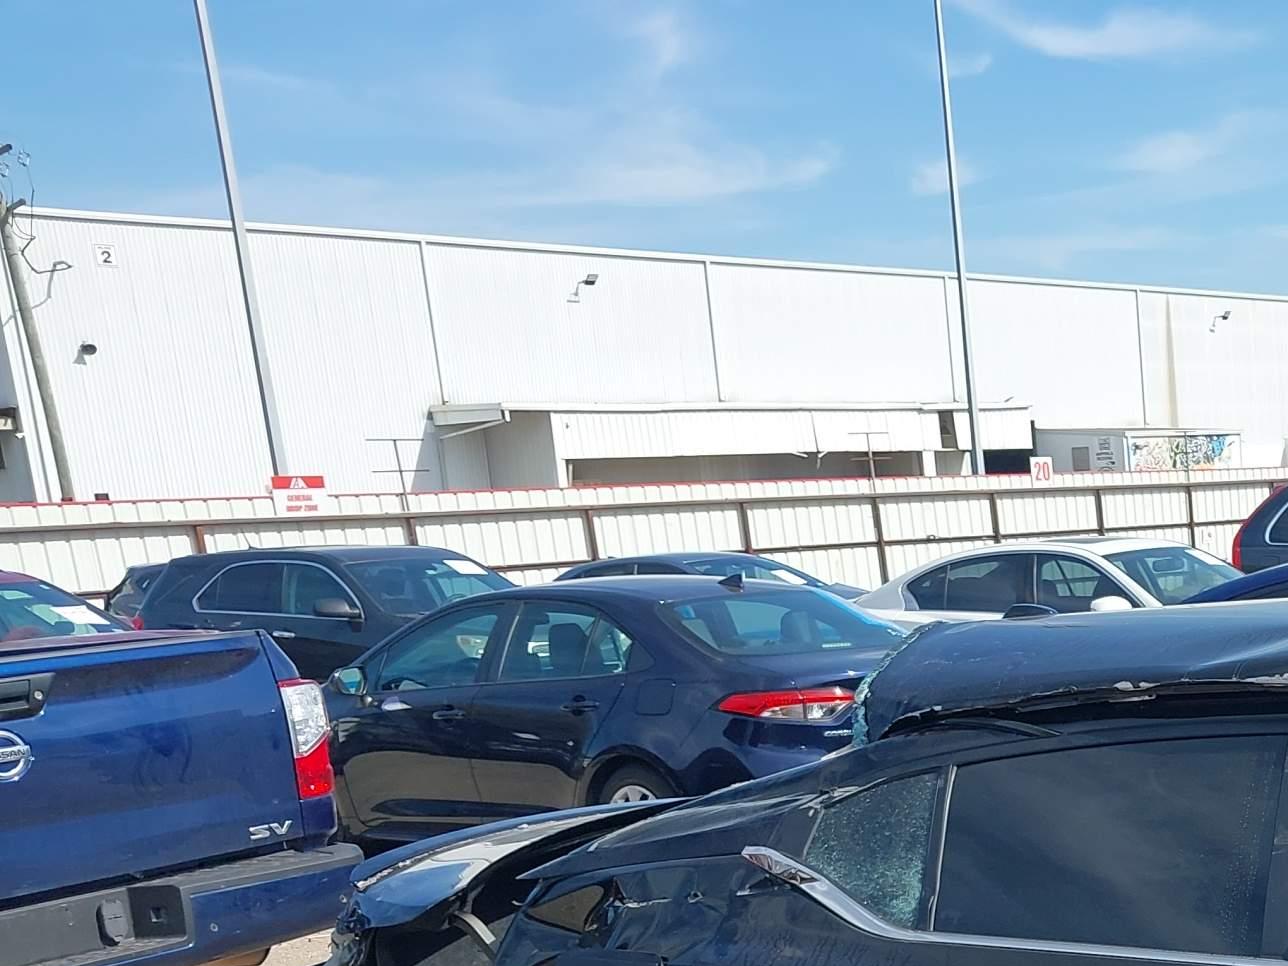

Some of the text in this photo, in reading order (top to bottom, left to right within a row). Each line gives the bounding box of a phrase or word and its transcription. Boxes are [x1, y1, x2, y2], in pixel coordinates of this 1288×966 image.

[101, 250, 112, 264] 2
[1034, 461, 1050, 481] 20
[0, 748, 26, 760] SAN
[248, 820, 292, 840] SV
